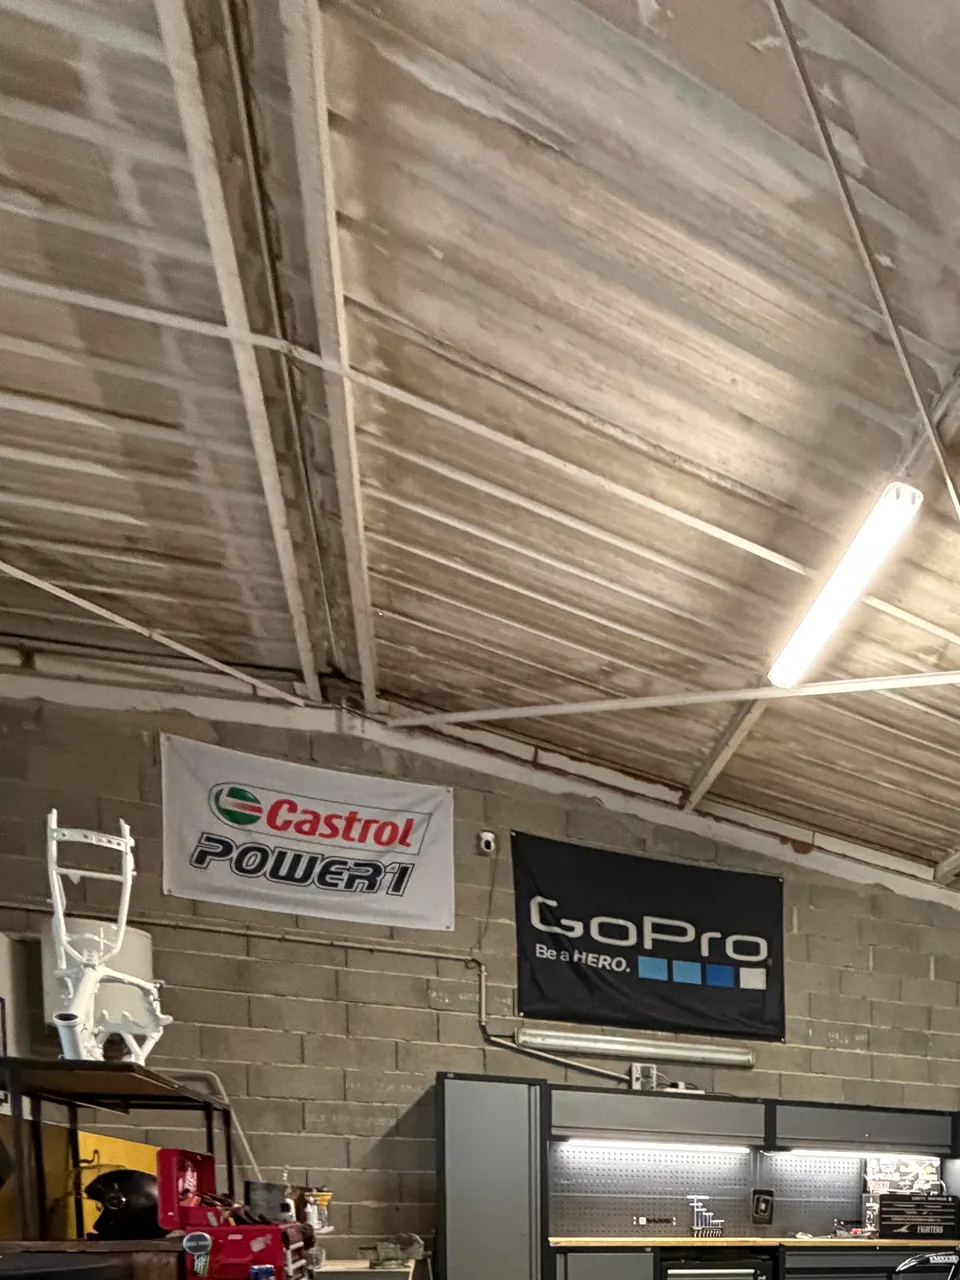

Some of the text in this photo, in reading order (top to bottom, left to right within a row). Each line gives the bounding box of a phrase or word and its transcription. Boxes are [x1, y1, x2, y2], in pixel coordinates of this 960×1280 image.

[266, 799, 414, 847] Castrol
[189, 832, 415, 896] POWER1
[529, 895, 768, 962] GoPro
[535, 943, 631, 973] Be a HERO.
[917, 1225, 944, 1234] FIGHTERS
